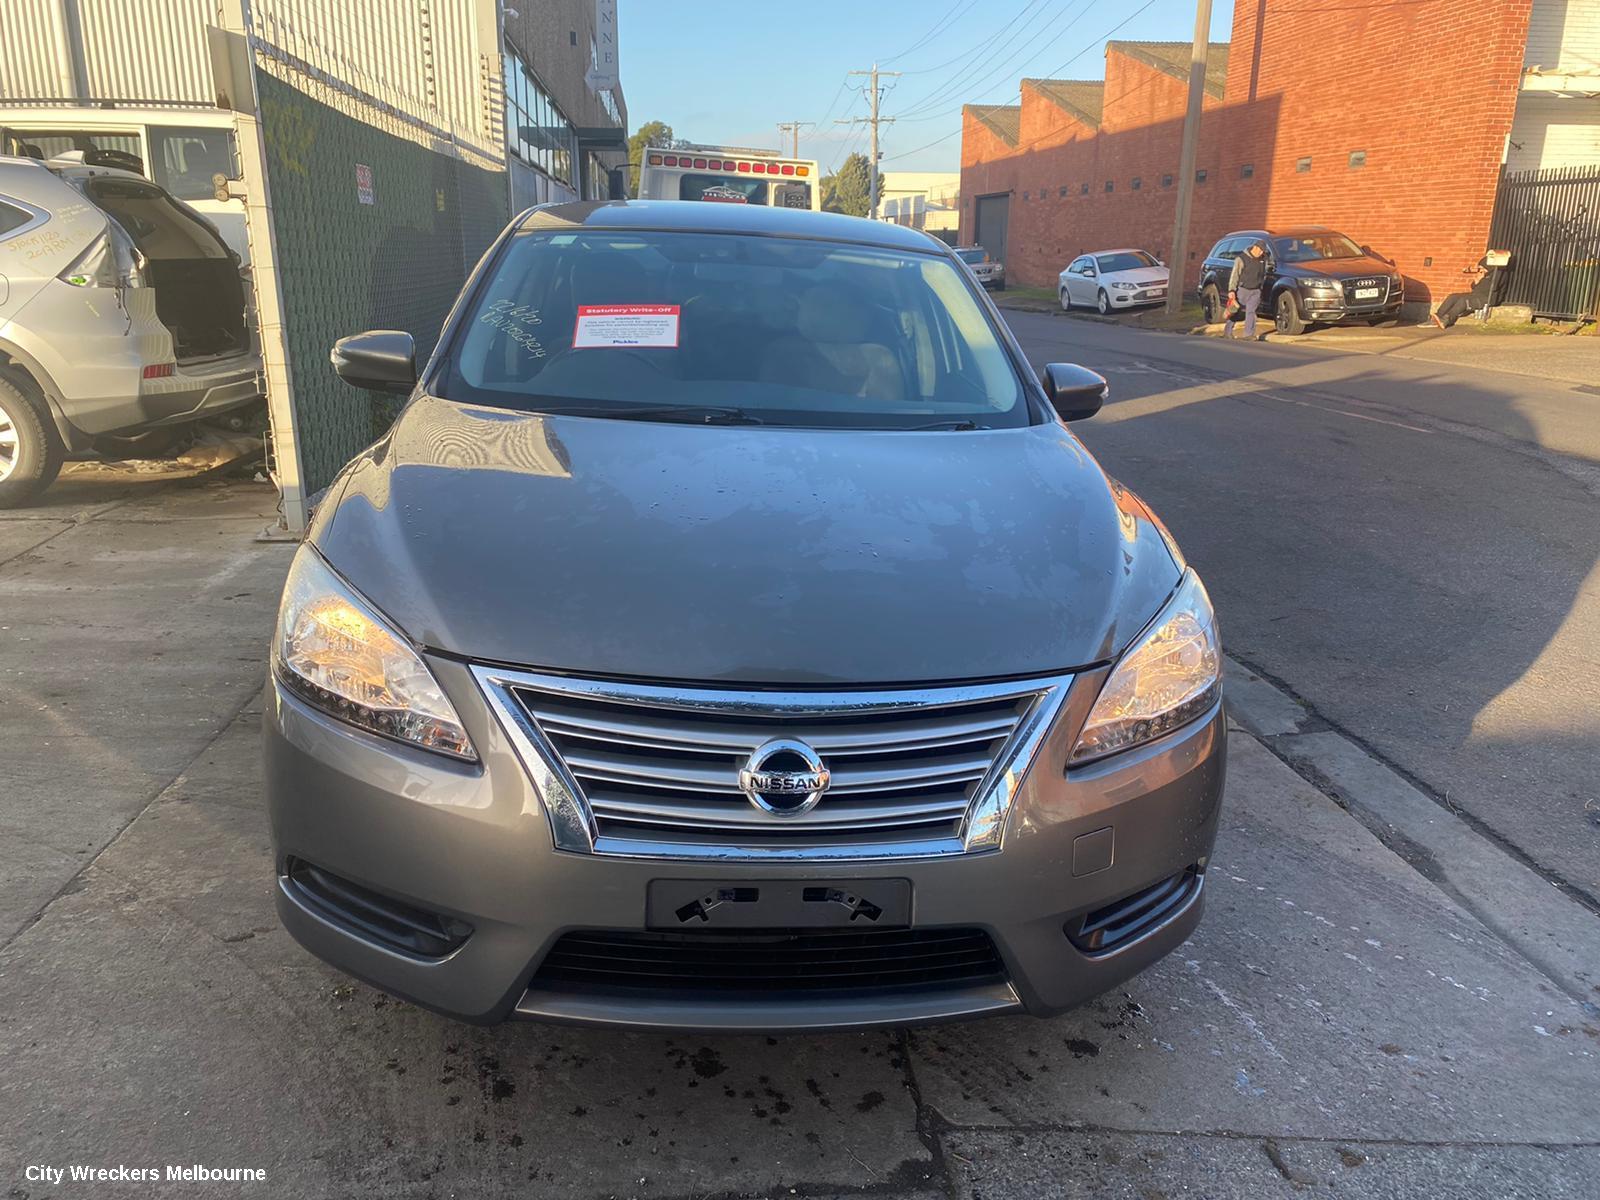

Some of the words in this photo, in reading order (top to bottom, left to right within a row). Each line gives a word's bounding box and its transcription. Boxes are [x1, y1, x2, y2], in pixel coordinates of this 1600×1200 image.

[600, 0, 613, 64] NNE
[586, 307, 629, 315] Statutory
[629, 306, 672, 314] Write-Off
[750, 777, 820, 790] NISSAN
